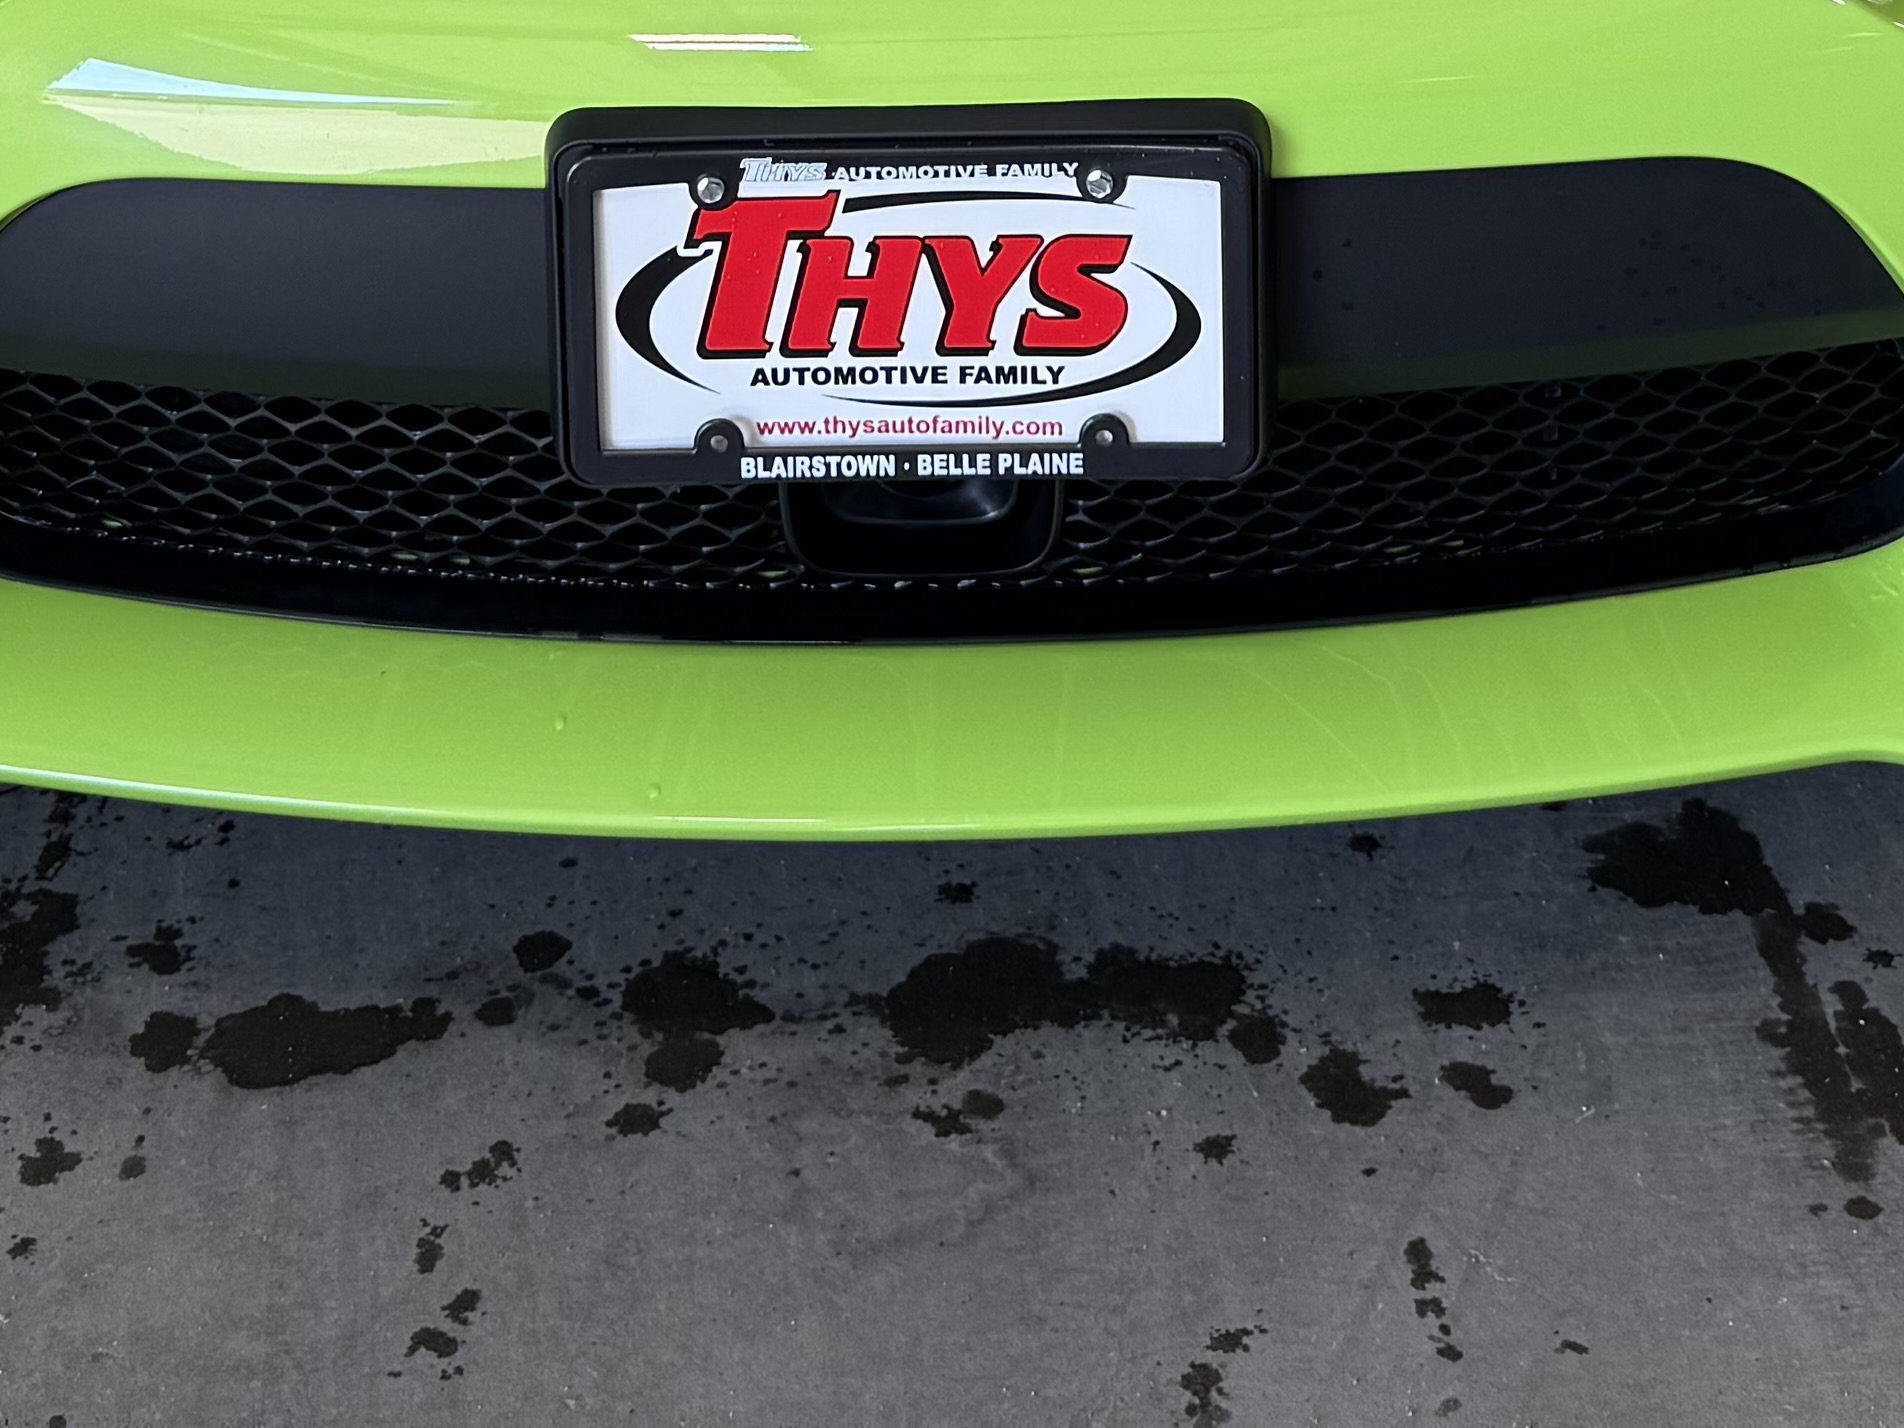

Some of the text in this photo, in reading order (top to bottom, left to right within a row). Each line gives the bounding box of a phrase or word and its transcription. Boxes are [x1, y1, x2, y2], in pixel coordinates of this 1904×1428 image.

[739, 156, 1080, 183] THYS AUTOMOTIVE FAMILY
[691, 189, 1133, 360] THYS
[749, 365, 1066, 387] AUTOMOTIVE FAMILY
[755, 415, 1064, 440] www.thysautofamily.com
[740, 451, 1085, 479] BLAIRSTOWN BELLE PLAINE
